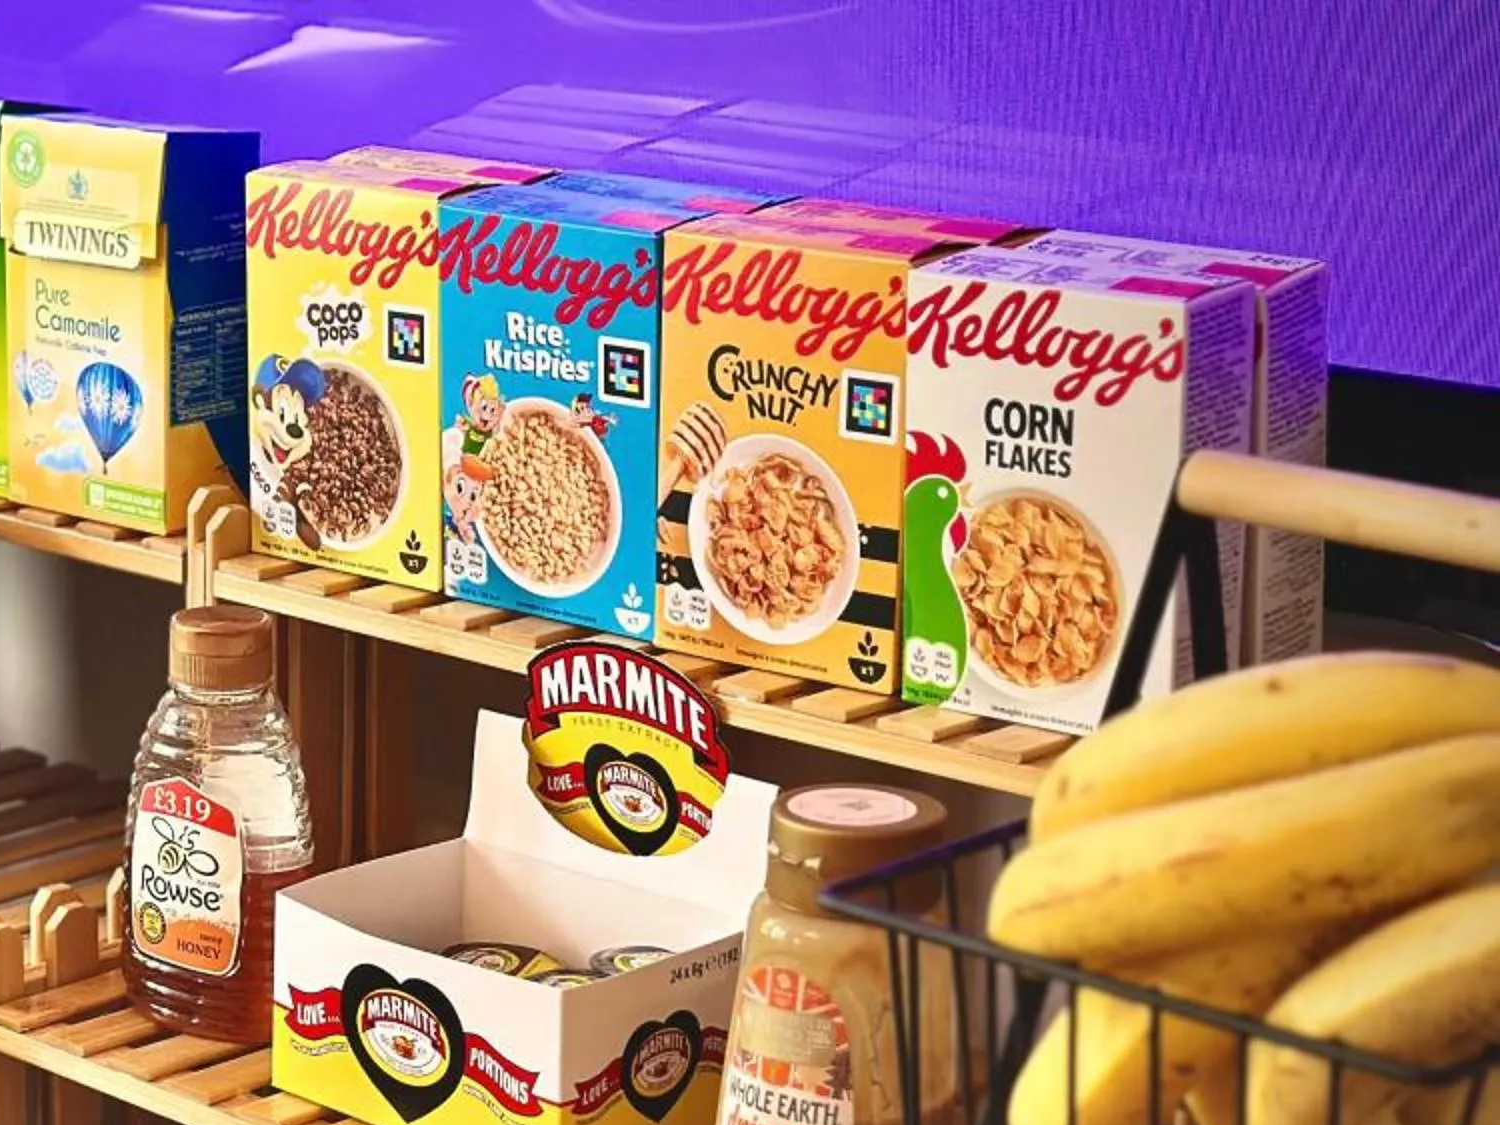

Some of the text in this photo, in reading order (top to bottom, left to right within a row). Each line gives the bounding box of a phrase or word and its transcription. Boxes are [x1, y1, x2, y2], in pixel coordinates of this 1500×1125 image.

[26, 219, 130, 259] TWININGS
[248, 183, 440, 289] Kellogg's
[439, 213, 659, 328] Kellogg's
[35, 278, 70, 307] Pure
[664, 244, 905, 361] Kellogg's
[35, 304, 121, 343] Camomile
[318, 323, 359, 348] pops
[505, 311, 564, 347] Rice
[906, 282, 1185, 406] Kellogg's
[484, 338, 591, 383] Krispies
[748, 394, 803, 426] NUT
[984, 398, 1075, 447] CORN
[984, 440, 1072, 480] FLAKES
[540, 653, 709, 751] MARMITE
[153, 786, 211, 823] £3.19
[141, 864, 221, 911] Rowse
[176, 937, 221, 960] HONEY
[366, 995, 438, 1038] MARMITE
[469, 1048, 530, 1105] PORTIONS
